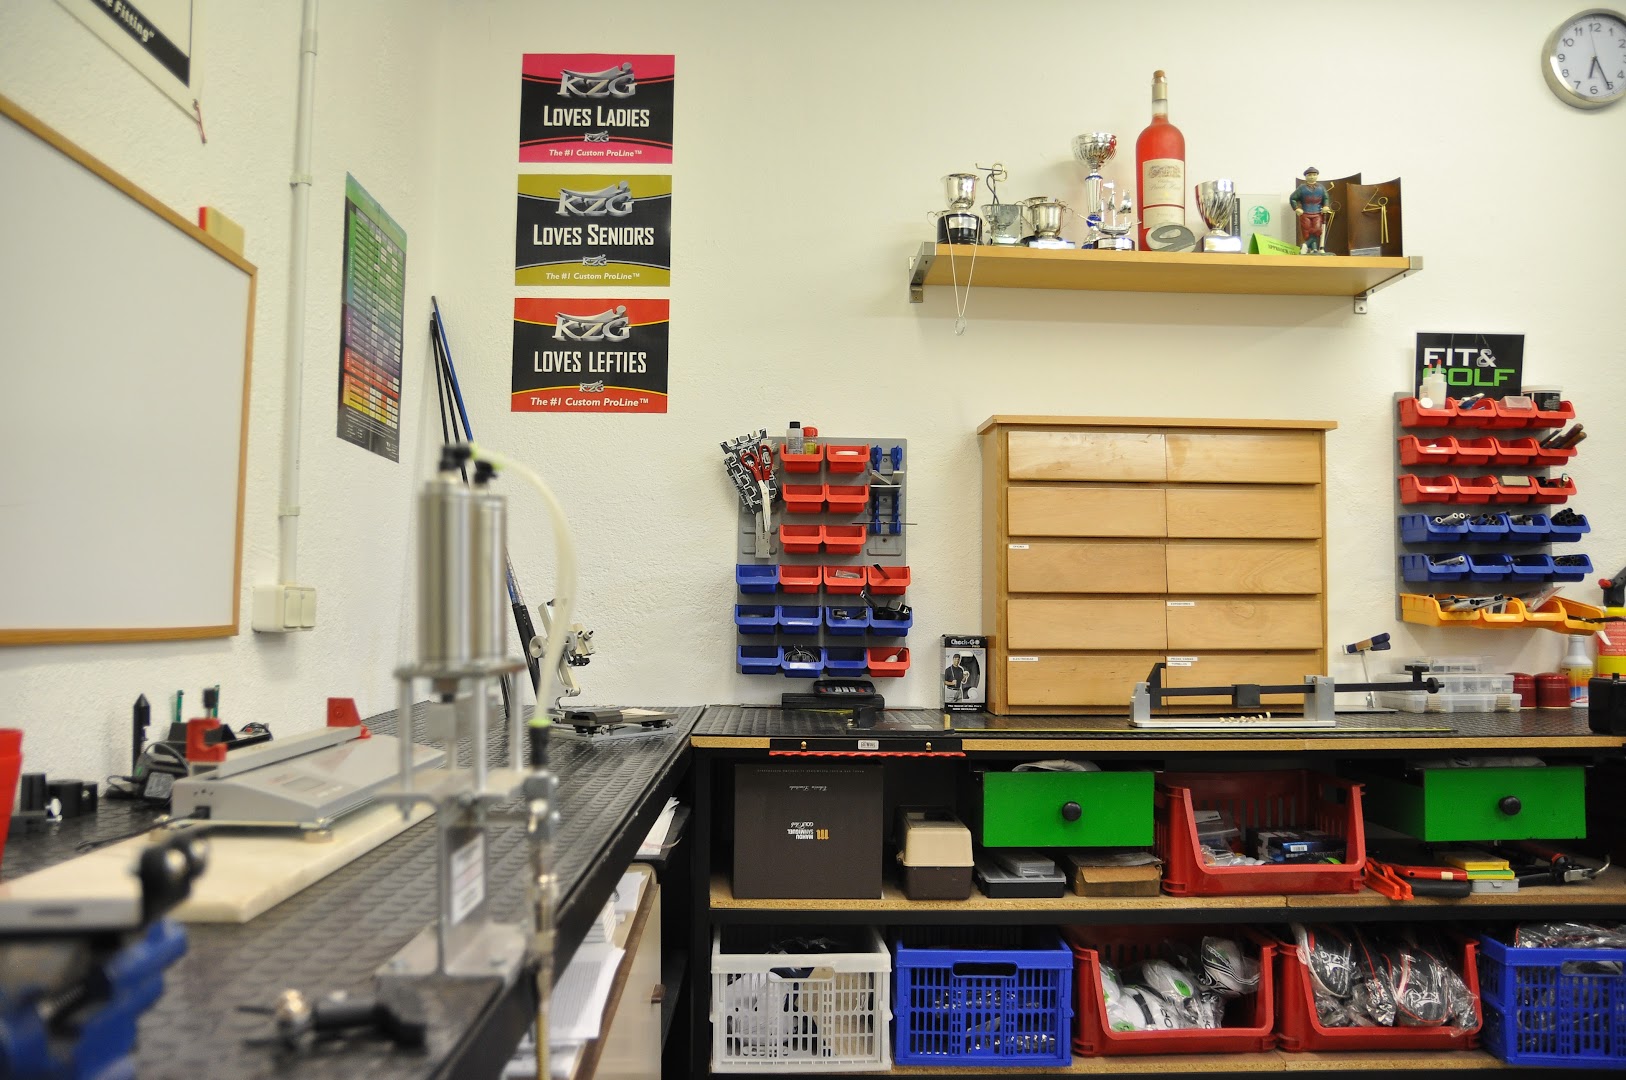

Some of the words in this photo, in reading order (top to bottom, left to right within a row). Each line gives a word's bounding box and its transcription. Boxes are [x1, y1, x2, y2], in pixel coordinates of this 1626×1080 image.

[1574, 27, 1583, 36] 11
[1588, 23, 1601, 32] 12
[1608, 28, 1613, 36] 1
[1562, 38, 1574, 47] 10
[1618, 39, 1626, 48] 2
[1557, 53, 1566, 62] 9
[1562, 69, 1569, 78] 8
[1617, 70, 1624, 78] 4
[557, 67, 637, 96] KZG
[1573, 80, 1581, 89] 7
[1606, 81, 1614, 90] 5
[1589, 86, 1598, 94] 6
[584, 131, 609, 142] KZG
[549, 149, 563, 157] The
[564, 149, 574, 157] #1
[576, 149, 604, 157] Custom
[555, 186, 634, 216] KZG
[582, 254, 607, 266] KZG
[546, 272, 560, 280] The
[561, 272, 571, 280] #1
[552, 310, 632, 341] KZG
[534, 350, 582, 373] LOVES
[588, 351, 647, 373] LEFTIES
[1423, 347, 1497, 368] FIT&
[579, 380, 604, 392] KZG
[530, 397, 548, 406] The
[549, 397, 561, 406] #1
[565, 398, 601, 406] Custom
